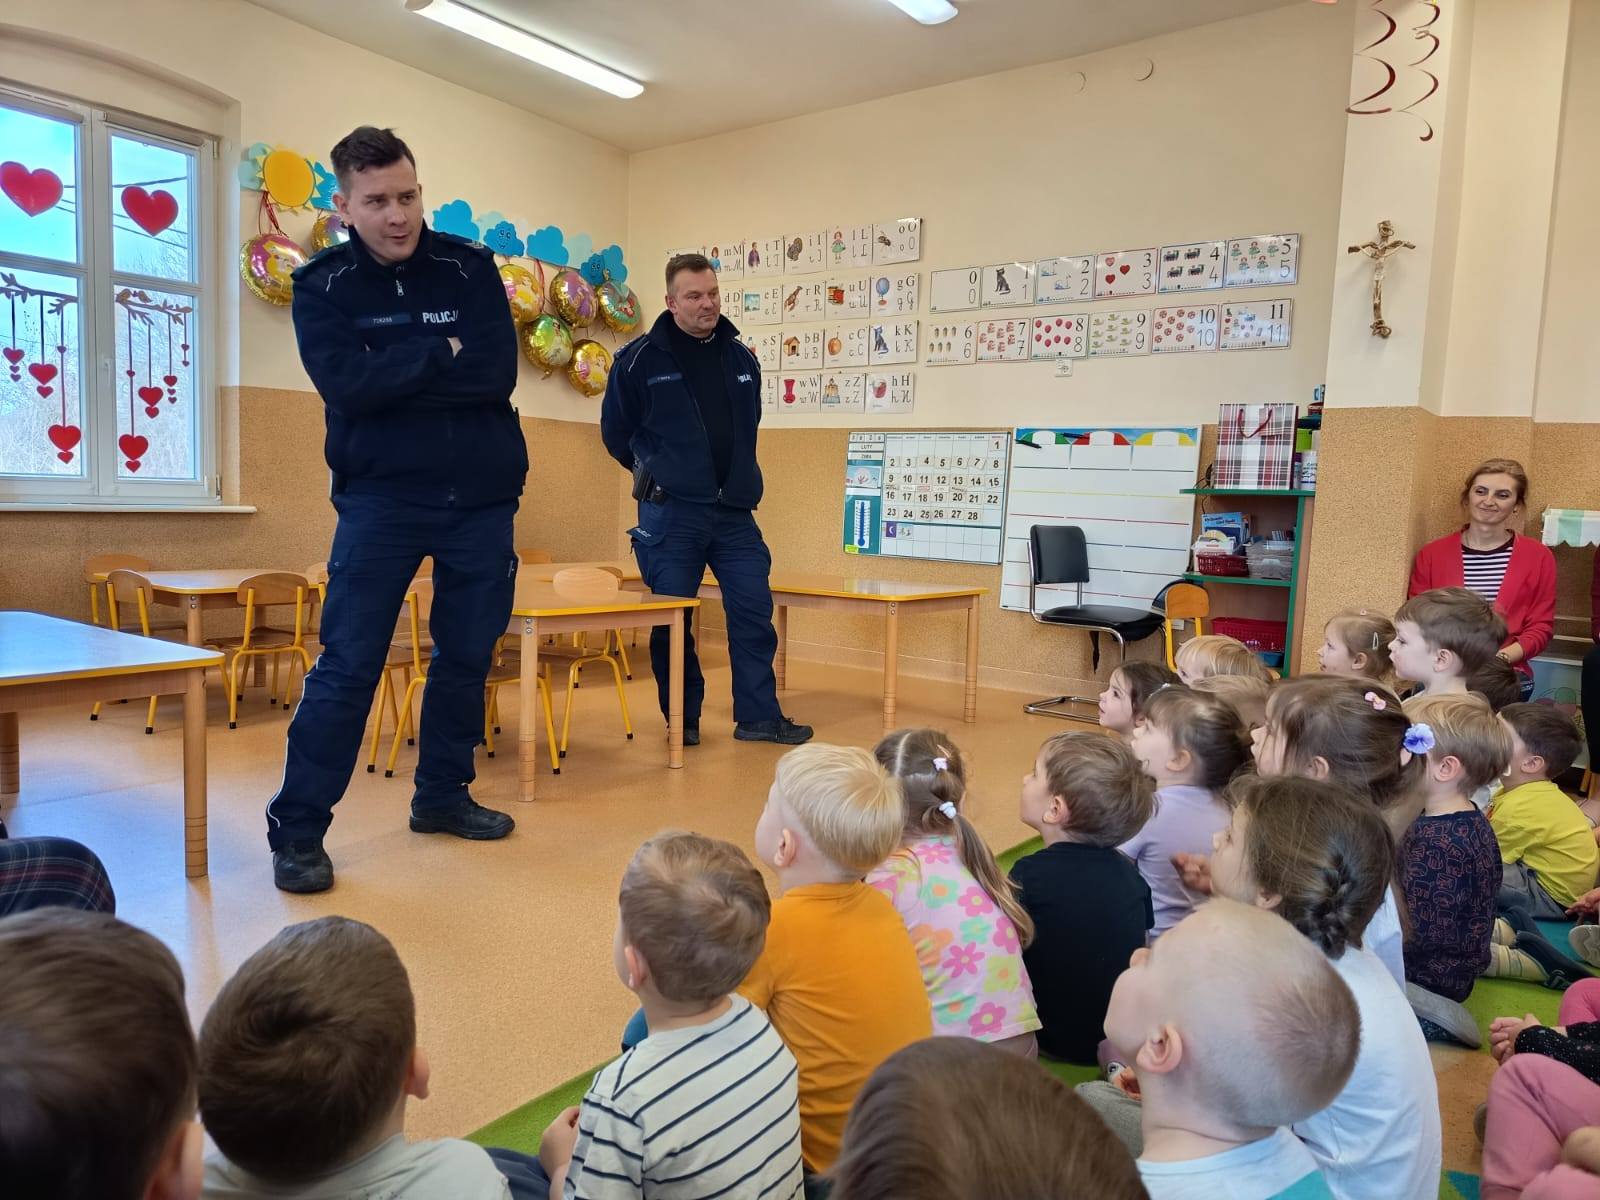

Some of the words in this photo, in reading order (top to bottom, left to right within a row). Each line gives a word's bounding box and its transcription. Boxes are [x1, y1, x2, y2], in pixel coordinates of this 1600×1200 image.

[1210, 246, 1220, 260] 4
[1282, 238, 1292, 254] 5
[1082, 260, 1090, 274] 2
[1144, 252, 1152, 268] 3
[1026, 266, 1028, 280] 1
[1210, 267, 1218, 282] 4
[1280, 259, 1291, 278] 5
[970, 270, 978, 284] 0
[1142, 272, 1152, 290] 3
[1022, 284, 1028, 300] 1
[1080, 278, 1089, 295] 2
[969, 289, 976, 304] 0
[1200, 308, 1216, 324] 10
[1271, 304, 1284, 320] 11
[1076, 317, 1084, 332] 8
[1136, 313, 1146, 328] 9
[896, 326, 901, 336] k
[904, 324, 912, 335] K
[964, 325, 972, 340] 6
[1019, 322, 1026, 336] 7
[1268, 325, 1283, 342] 11
[1074, 336, 1082, 352] 8
[1136, 332, 1145, 349] 9
[1197, 329, 1215, 346] 10
[964, 343, 972, 358] 6
[1017, 340, 1025, 356] 7
[995, 441, 999, 449] 1
[958, 458, 962, 466] 6
[974, 458, 980, 466] 7
[994, 460, 998, 468] 8
[954, 476, 963, 484] 13
[990, 478, 999, 486] 15
[918, 494, 928, 502] 18
[934, 494, 944, 502] 19
[952, 493, 962, 501] 20
[987, 495, 998, 504] 22
[920, 510, 930, 518] 25
[934, 510, 944, 518] 26
[952, 510, 962, 518] 27
[968, 512, 978, 520] 28
